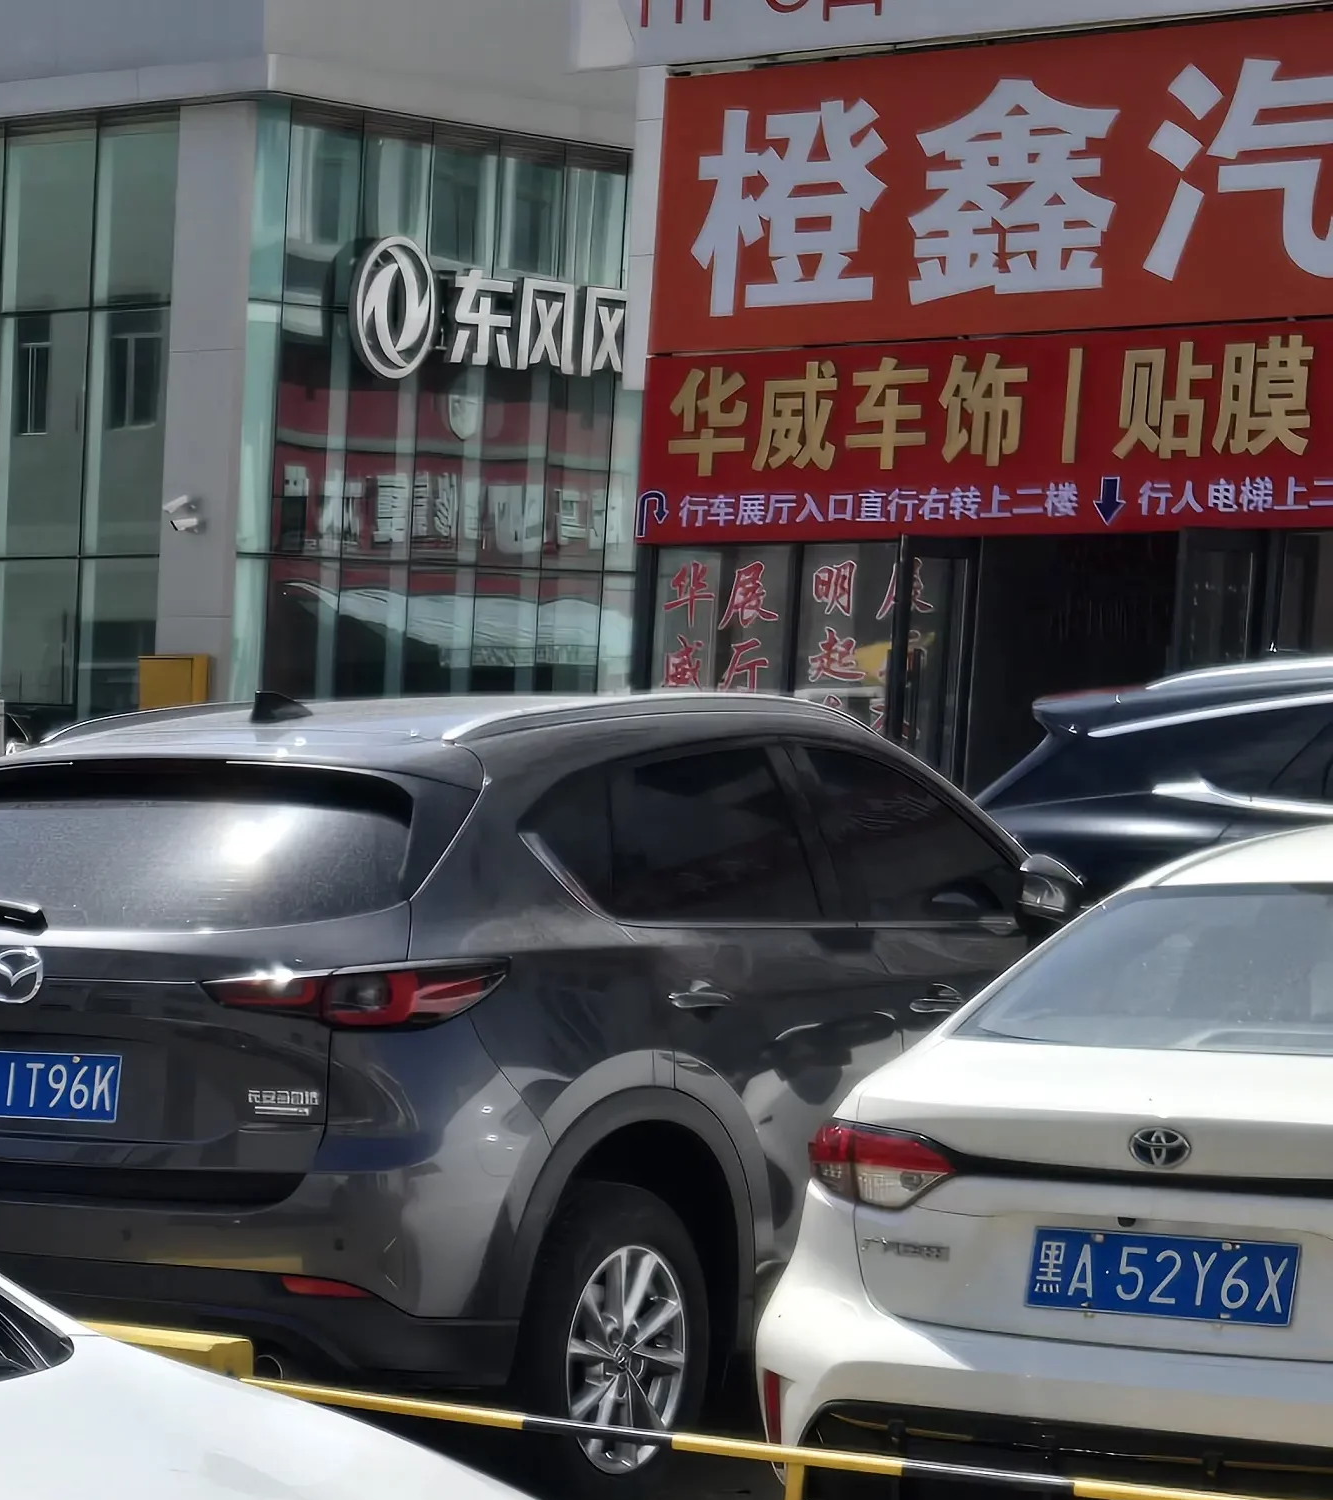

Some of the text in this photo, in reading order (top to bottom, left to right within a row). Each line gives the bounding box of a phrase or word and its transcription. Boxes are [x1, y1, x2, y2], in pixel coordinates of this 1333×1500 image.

[691, 58, 1333, 318] 橙鑫汽
[668, 334, 1315, 477] 华威车饰 贴膜
[679, 482, 1079, 528] 行车展厅入口直行右转上二楼
[1138, 476, 1333, 517] 行人电梯上二
